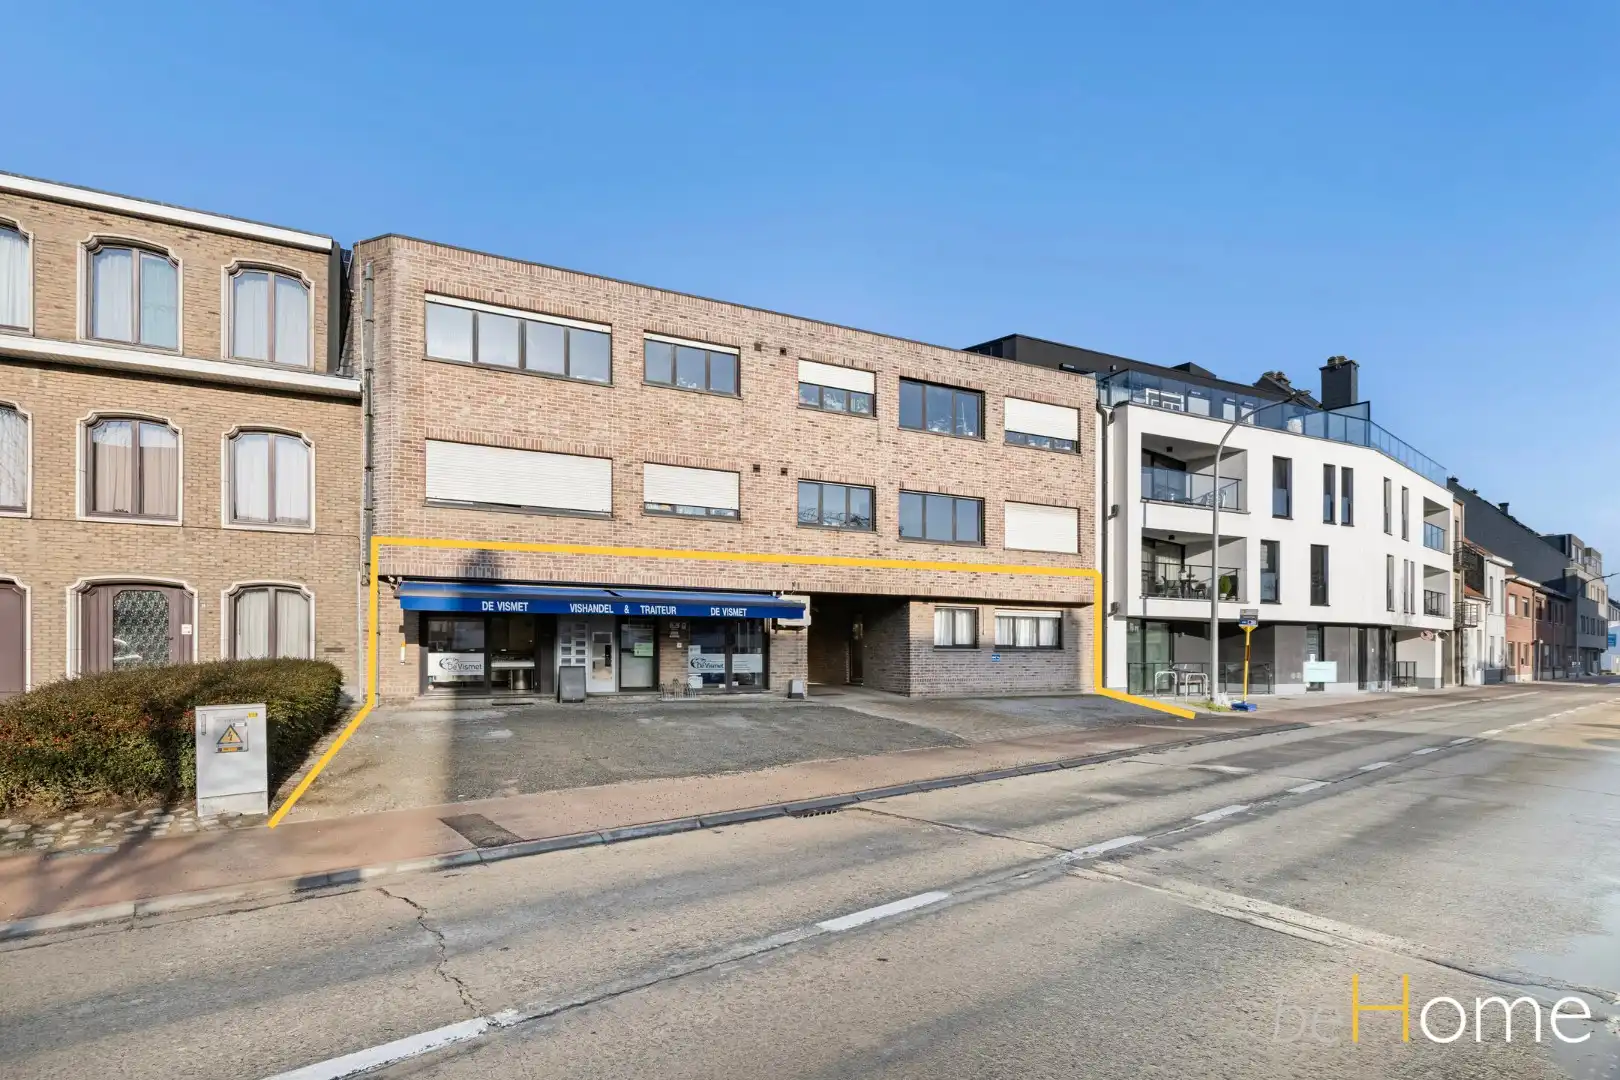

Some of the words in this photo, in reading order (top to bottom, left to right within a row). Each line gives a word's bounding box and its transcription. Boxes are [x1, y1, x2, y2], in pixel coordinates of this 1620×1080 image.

[481, 601, 494, 611] DE
[496, 601, 529, 612] VISMET
[569, 603, 614, 614] VISHANDEL
[623, 604, 630, 614] &
[640, 604, 677, 615] TRAITEUR
[710, 607, 720, 616] DE
[721, 607, 747, 617] VISMET
